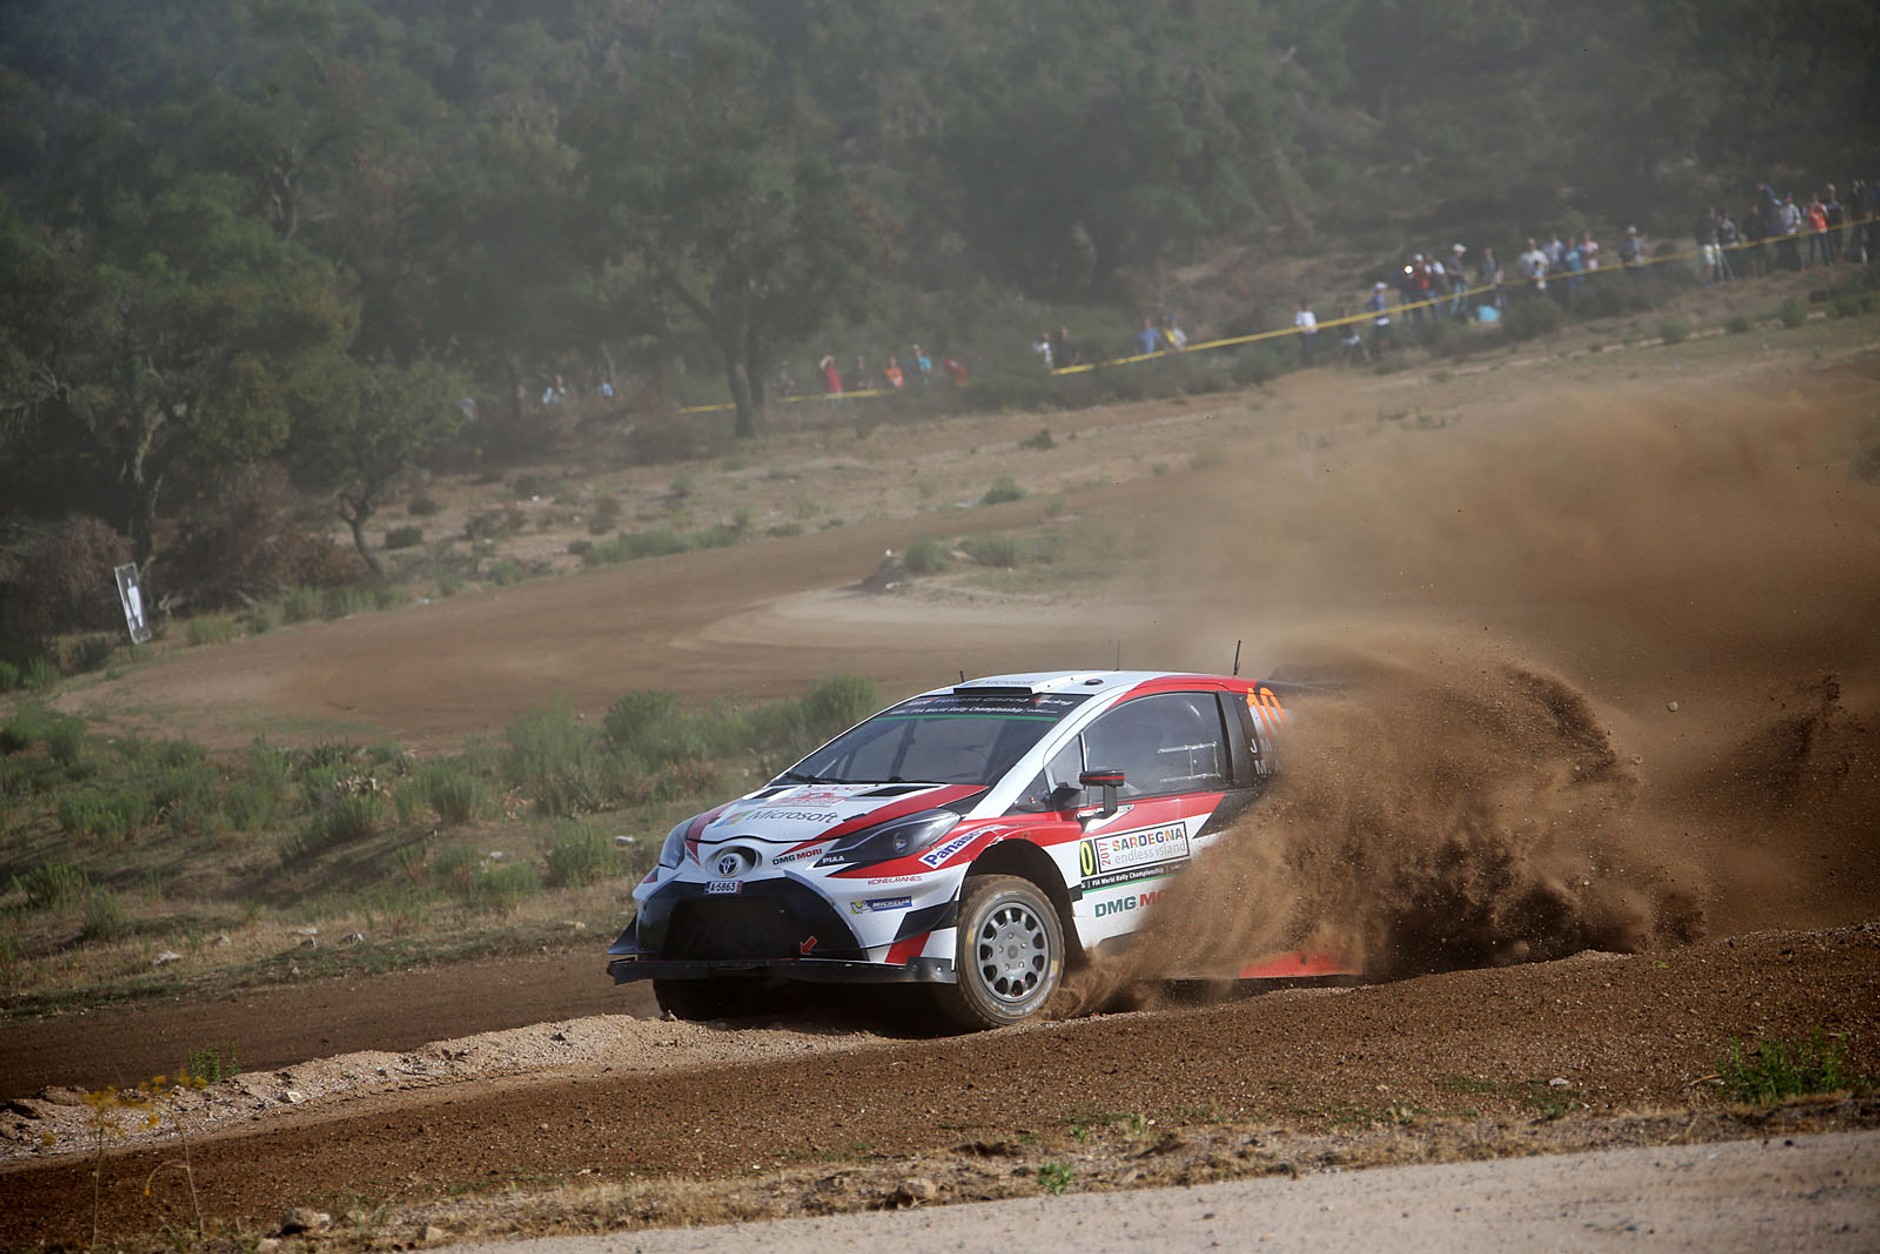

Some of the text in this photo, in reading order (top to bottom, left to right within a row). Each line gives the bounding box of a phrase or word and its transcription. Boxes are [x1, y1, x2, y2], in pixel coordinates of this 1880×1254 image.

[1245, 687, 1288, 734] 10
[746, 810, 838, 824] Microsoft
[1112, 828, 1184, 852] SARDEGNA
[772, 848, 823, 866] DMG MORI
[822, 855, 845, 864] PIAA
[1098, 842, 1111, 867] 2017
[1114, 841, 1186, 864] endless island
[867, 875, 923, 886] KONECRANES
[1102, 875, 1115, 885] World
[1116, 873, 1128, 882] Rally
[1129, 867, 1165, 879] Championship
[1094, 896, 1137, 918] DMG
